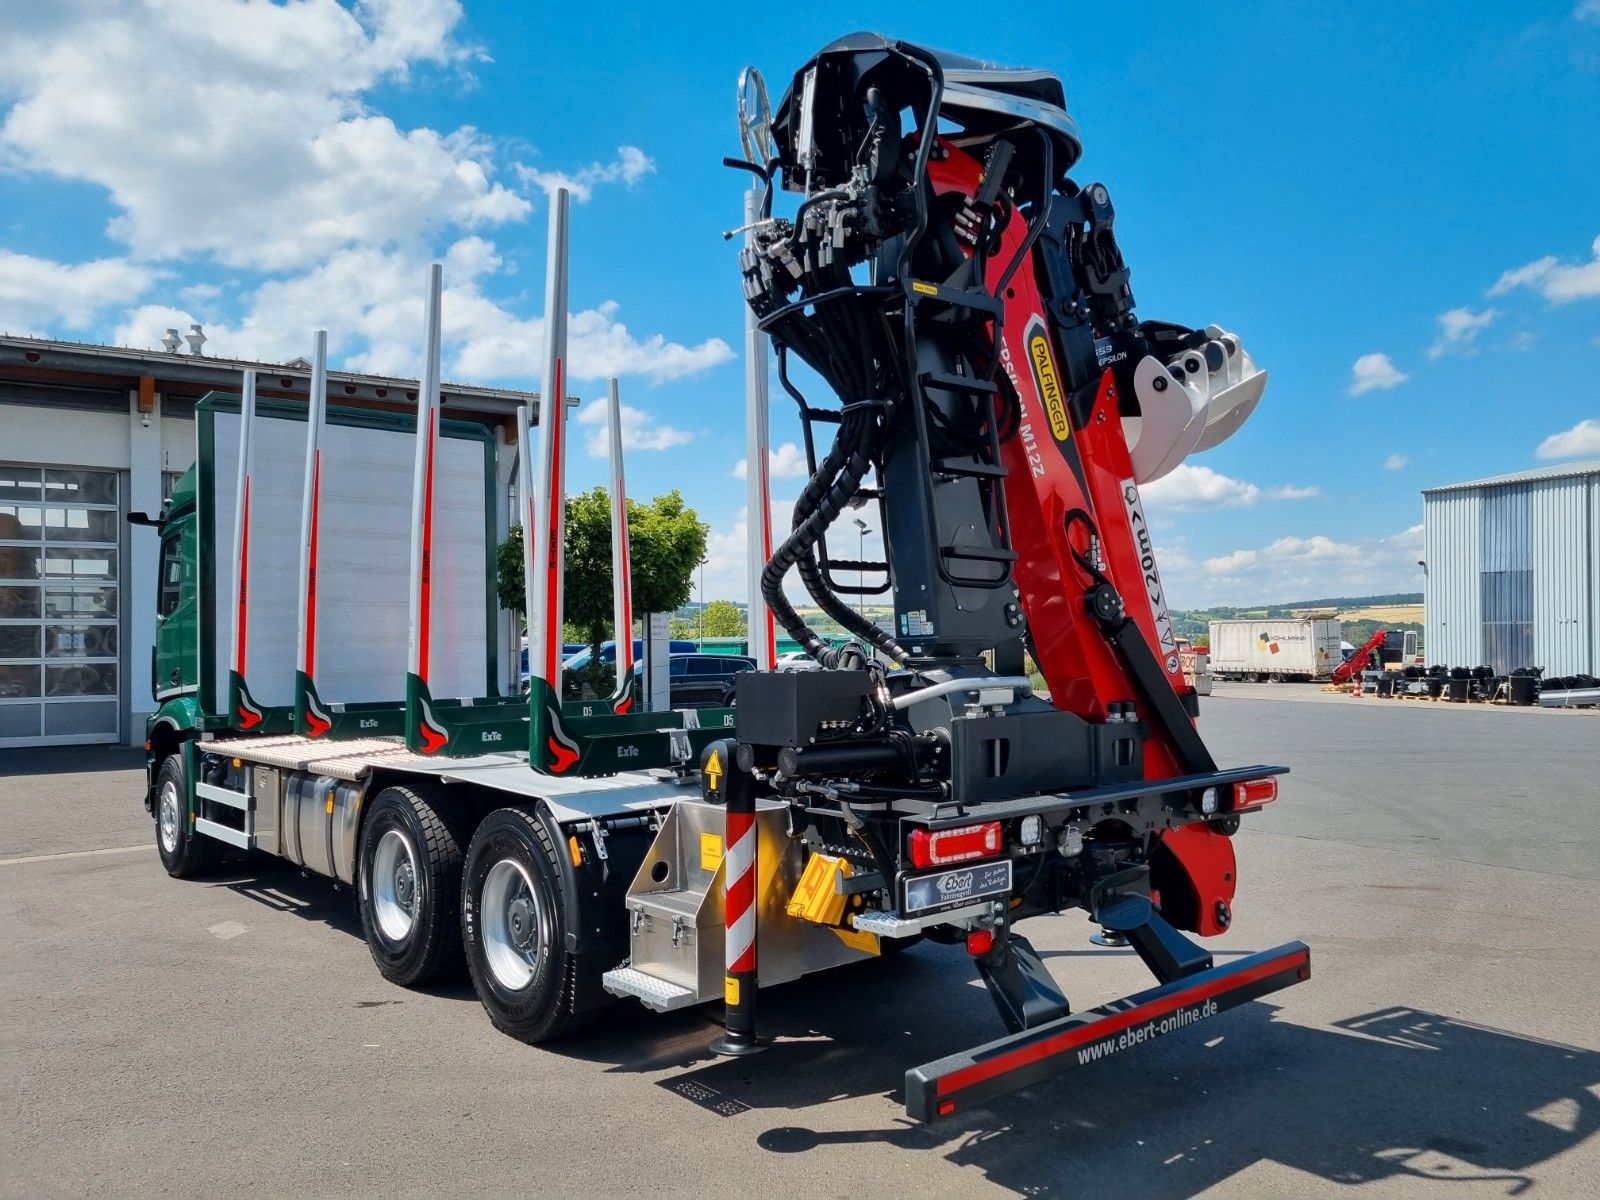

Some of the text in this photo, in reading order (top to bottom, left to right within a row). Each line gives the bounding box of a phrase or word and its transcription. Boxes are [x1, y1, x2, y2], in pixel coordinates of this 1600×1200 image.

[1034, 343, 1066, 434] PALFINGER
[1020, 424, 1045, 479] M12Z
[1137, 528, 1159, 588] 20m
[583, 706, 593, 717] D5
[360, 719, 379, 729] ExTe
[723, 714, 734, 727] D5
[481, 731, 502, 742] ExTe
[617, 745, 639, 758] ExTe
[945, 874, 972, 892] Ebert
[1077, 999, 1218, 1065] www.ebert-online.de
